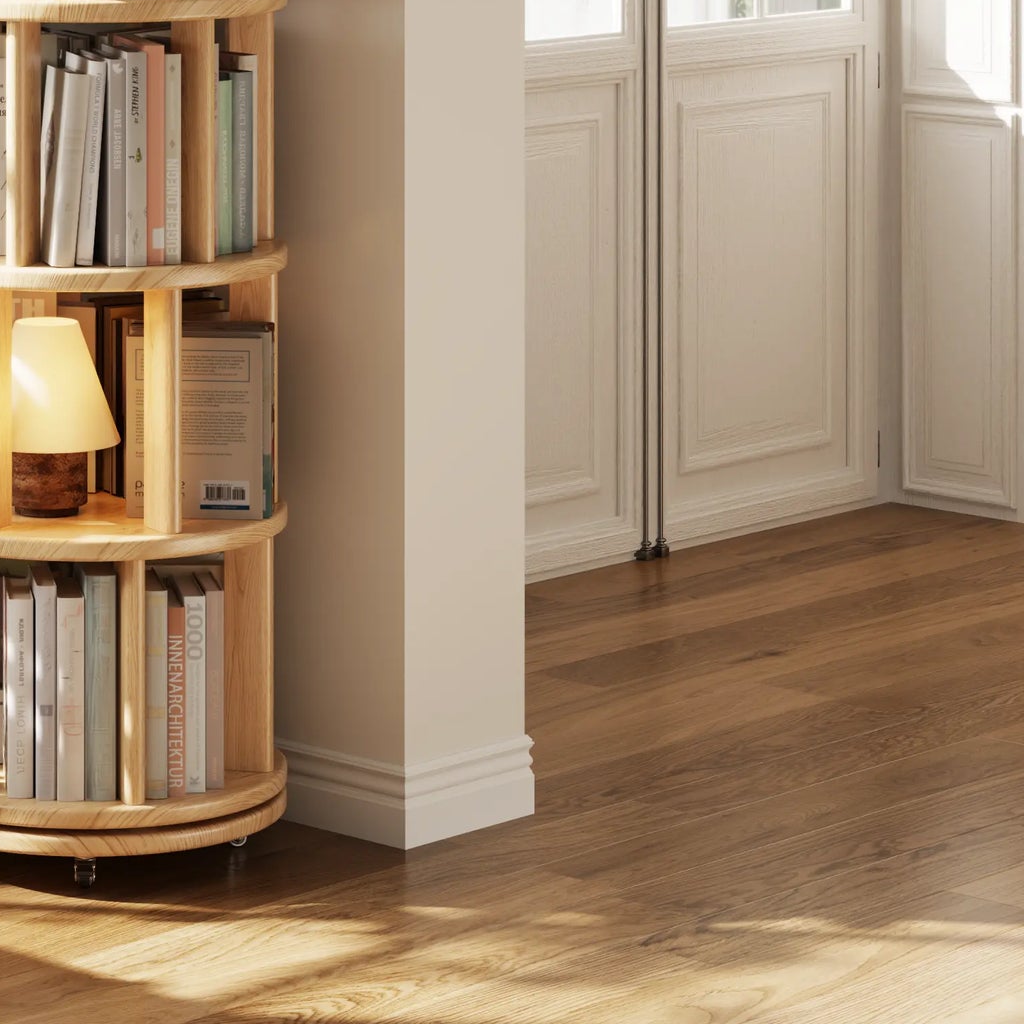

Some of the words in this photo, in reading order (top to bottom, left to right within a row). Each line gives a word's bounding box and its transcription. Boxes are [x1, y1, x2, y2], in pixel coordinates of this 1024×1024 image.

[130, 66, 139, 84] KING
[130, 86, 139, 117] STEPHEN
[166, 157, 178, 205] ONEGIN
[166, 208, 179, 256] EUGENE
[185, 602, 203, 661] 1000
[168, 634, 184, 788] INNENARCHITEKTUR
